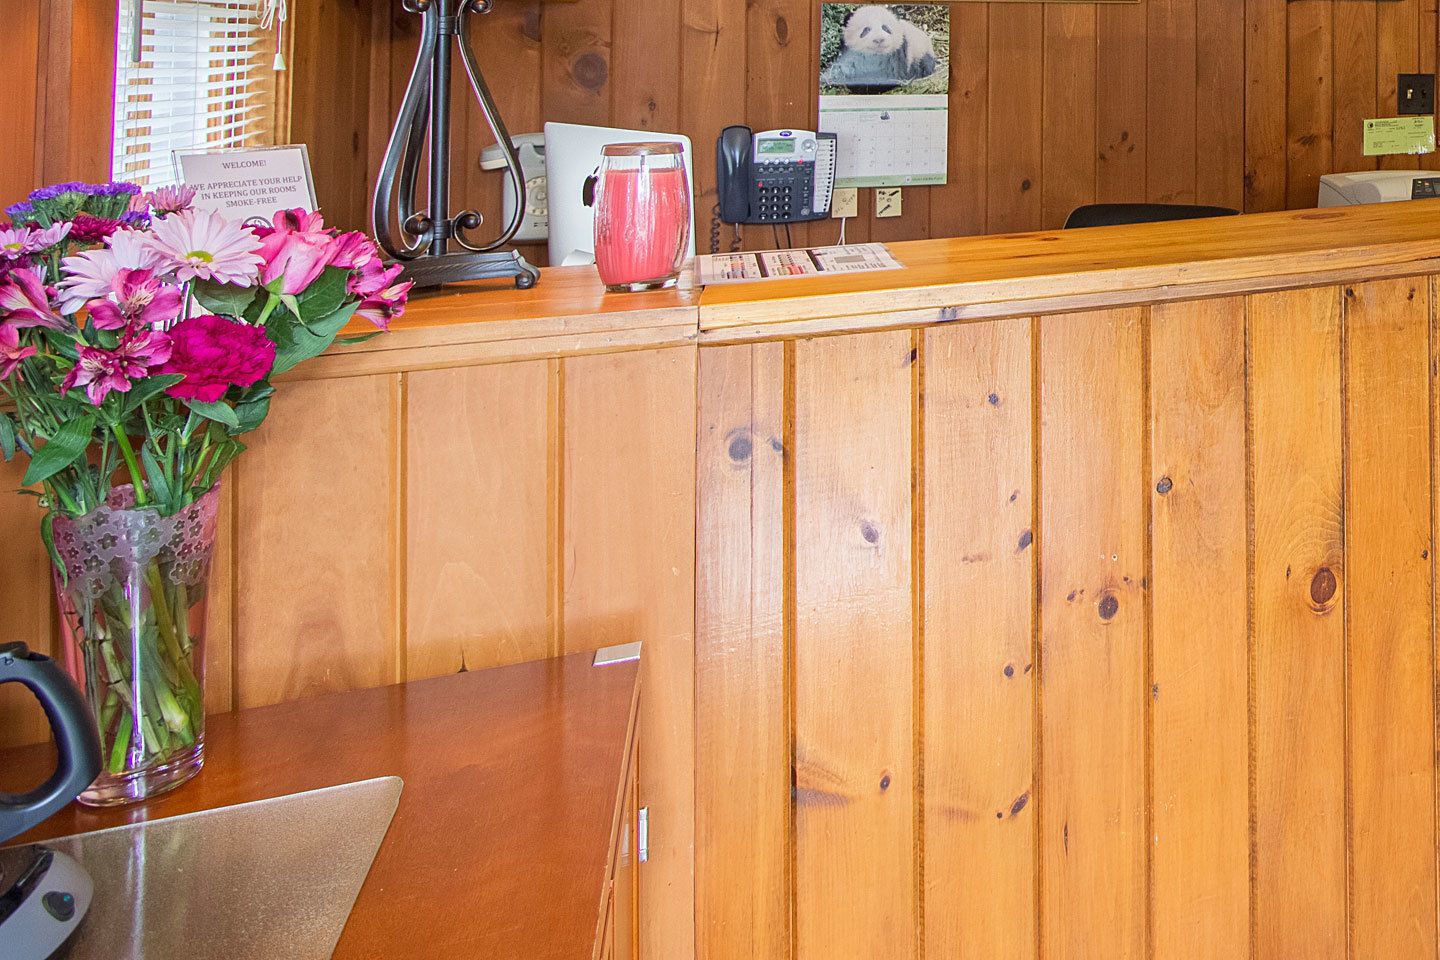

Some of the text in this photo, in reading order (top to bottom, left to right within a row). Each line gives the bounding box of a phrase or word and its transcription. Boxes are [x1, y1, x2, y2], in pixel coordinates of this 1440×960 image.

[222, 159, 267, 170] WELCOME!
[190, 175, 303, 191] WE APPRECIATE YOUR HELP
[201, 185, 297, 201] IN KEEPING OUR ROOMS
[225, 196, 278, 208] SMOKE-FREE
